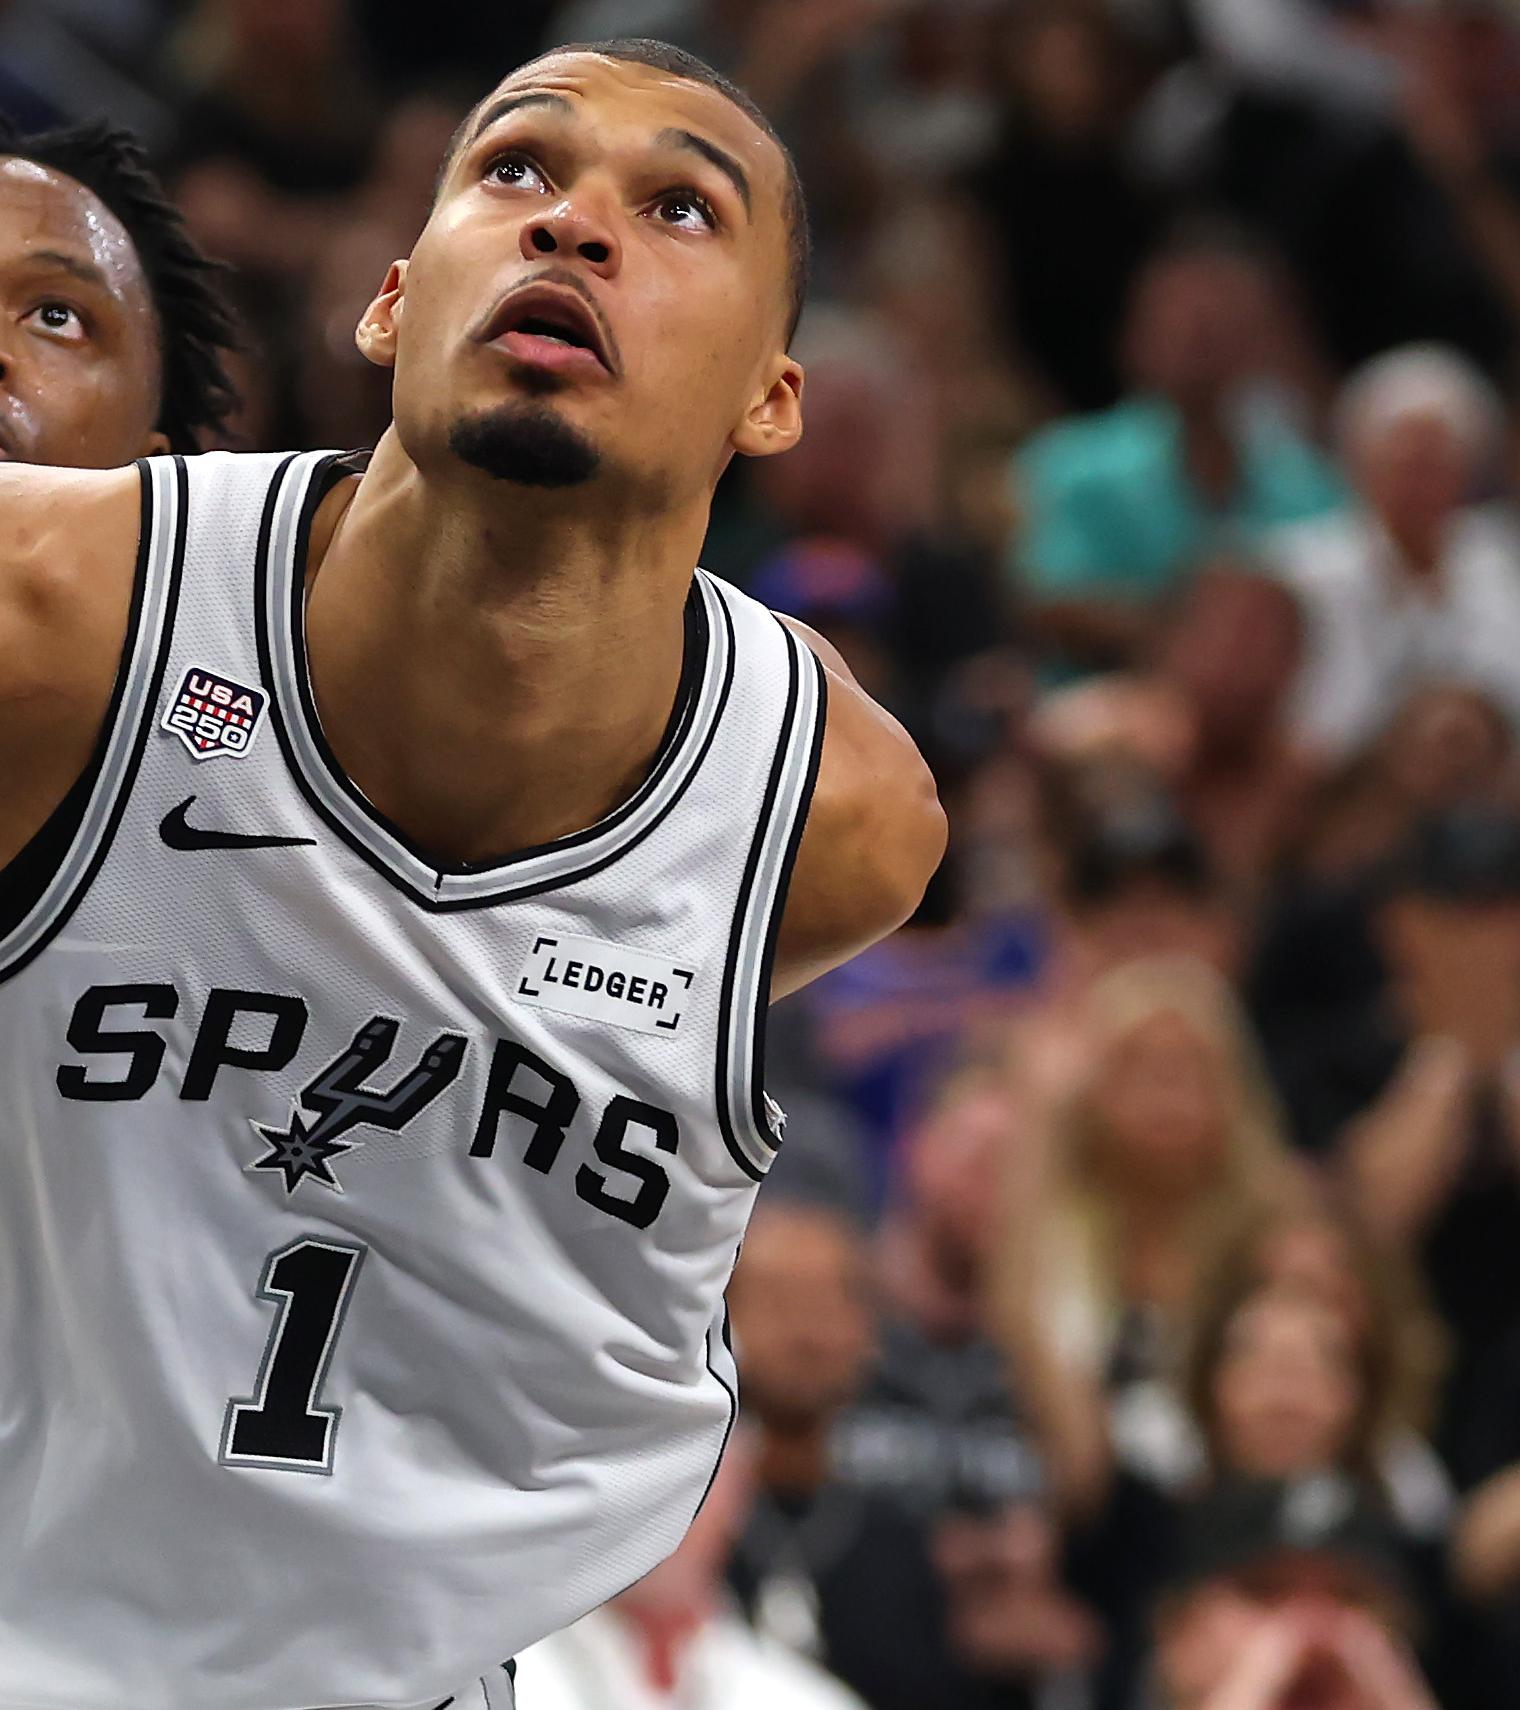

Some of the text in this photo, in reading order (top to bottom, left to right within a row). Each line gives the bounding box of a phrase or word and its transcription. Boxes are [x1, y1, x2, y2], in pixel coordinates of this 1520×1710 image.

[188, 674, 254, 717] USA
[170, 704, 248, 750] 250
[543, 957, 668, 1009] LEDGER
[56, 984, 679, 1230] SPURS
[218, 1234, 368, 1476] 1
